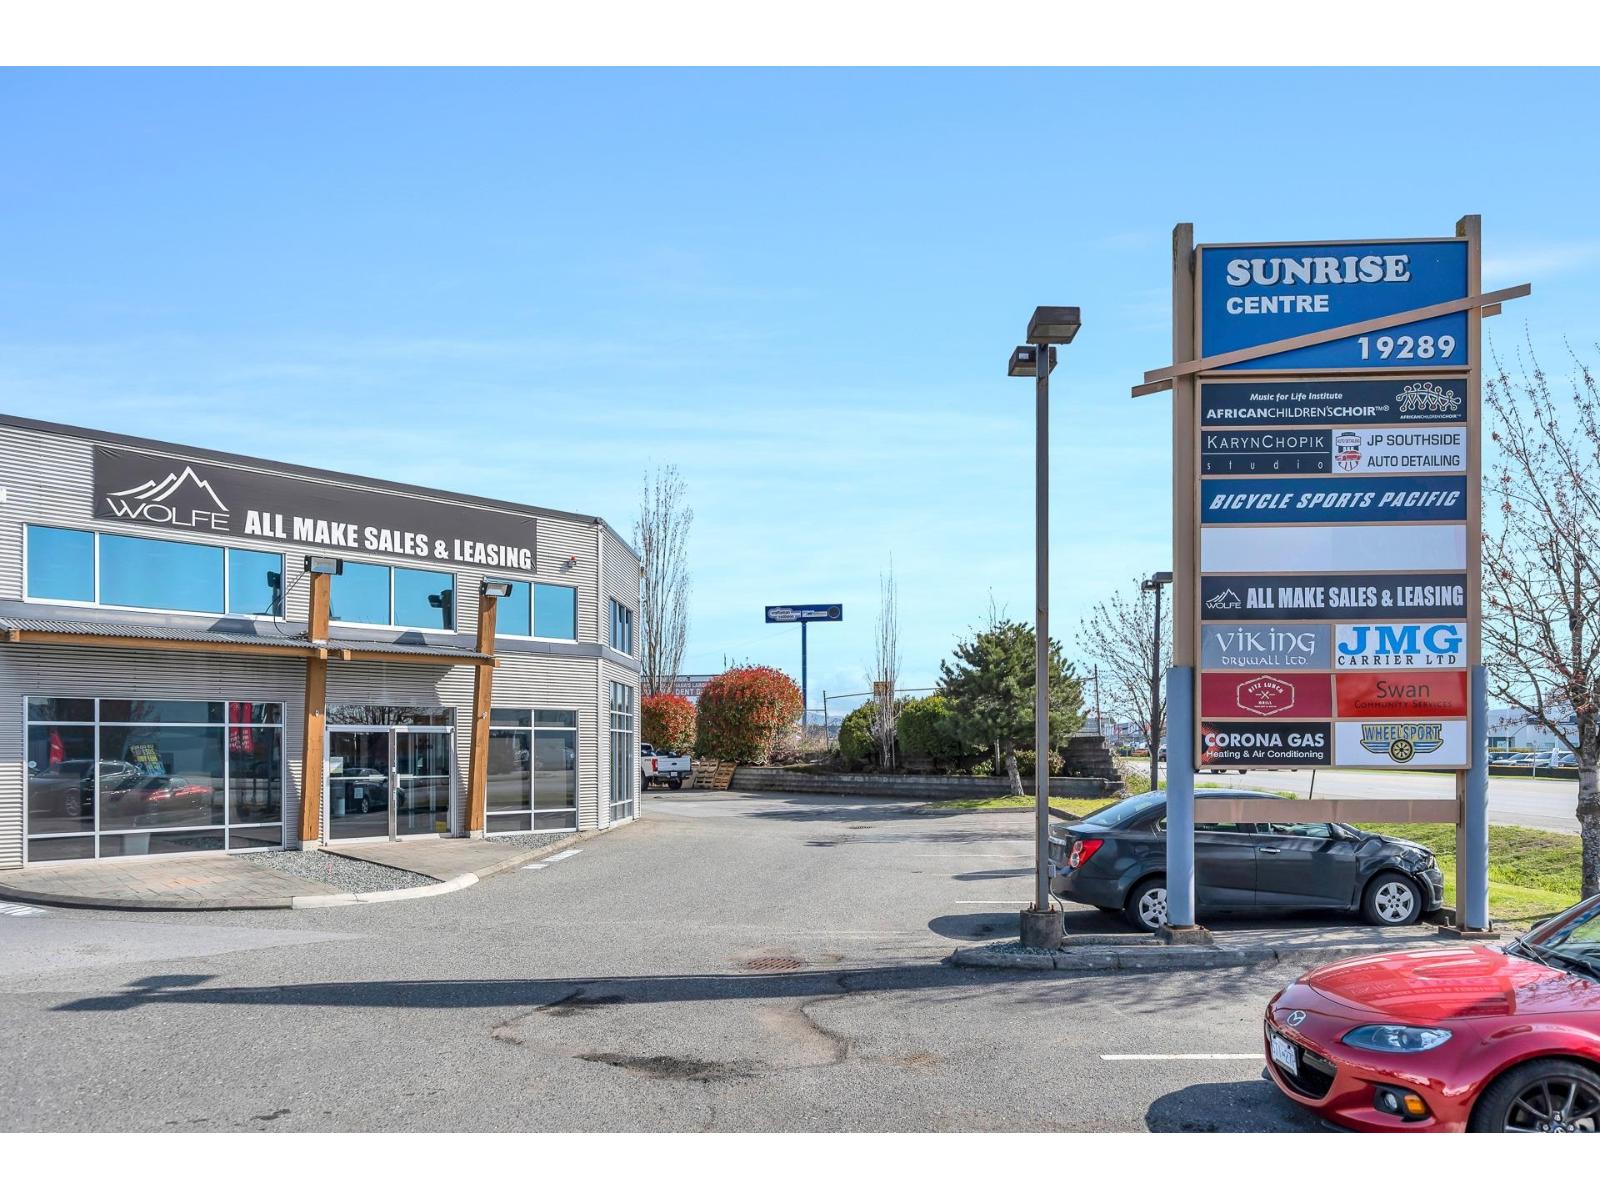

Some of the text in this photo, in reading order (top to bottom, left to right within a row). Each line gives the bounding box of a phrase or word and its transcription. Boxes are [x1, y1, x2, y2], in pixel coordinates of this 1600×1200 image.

[1226, 254, 1411, 286] SUNRISE
[1226, 294, 1329, 315] CENTRE
[1357, 335, 1456, 360] 19289
[1250, 392, 1343, 402] Music for Life Institute
[1367, 433, 1461, 446] JP SOUTHSIDE
[1367, 454, 1460, 467] AUTO DETAILING
[1208, 490, 1461, 510] BICYCLE SPORTS PACIFIC
[106, 497, 230, 531] WOLFE
[244, 510, 532, 570] ALL MAKE SALES & LEASING
[1246, 585, 1463, 608] ALL MAKE SALES & LEASING
[1338, 624, 1462, 655] JMG
[1338, 654, 1457, 666] CARRIER LTD
[1376, 680, 1430, 699] Swan
[1204, 733, 1325, 747] CORONA GAS
[1206, 750, 1323, 760] Heating & Air Conditioning
